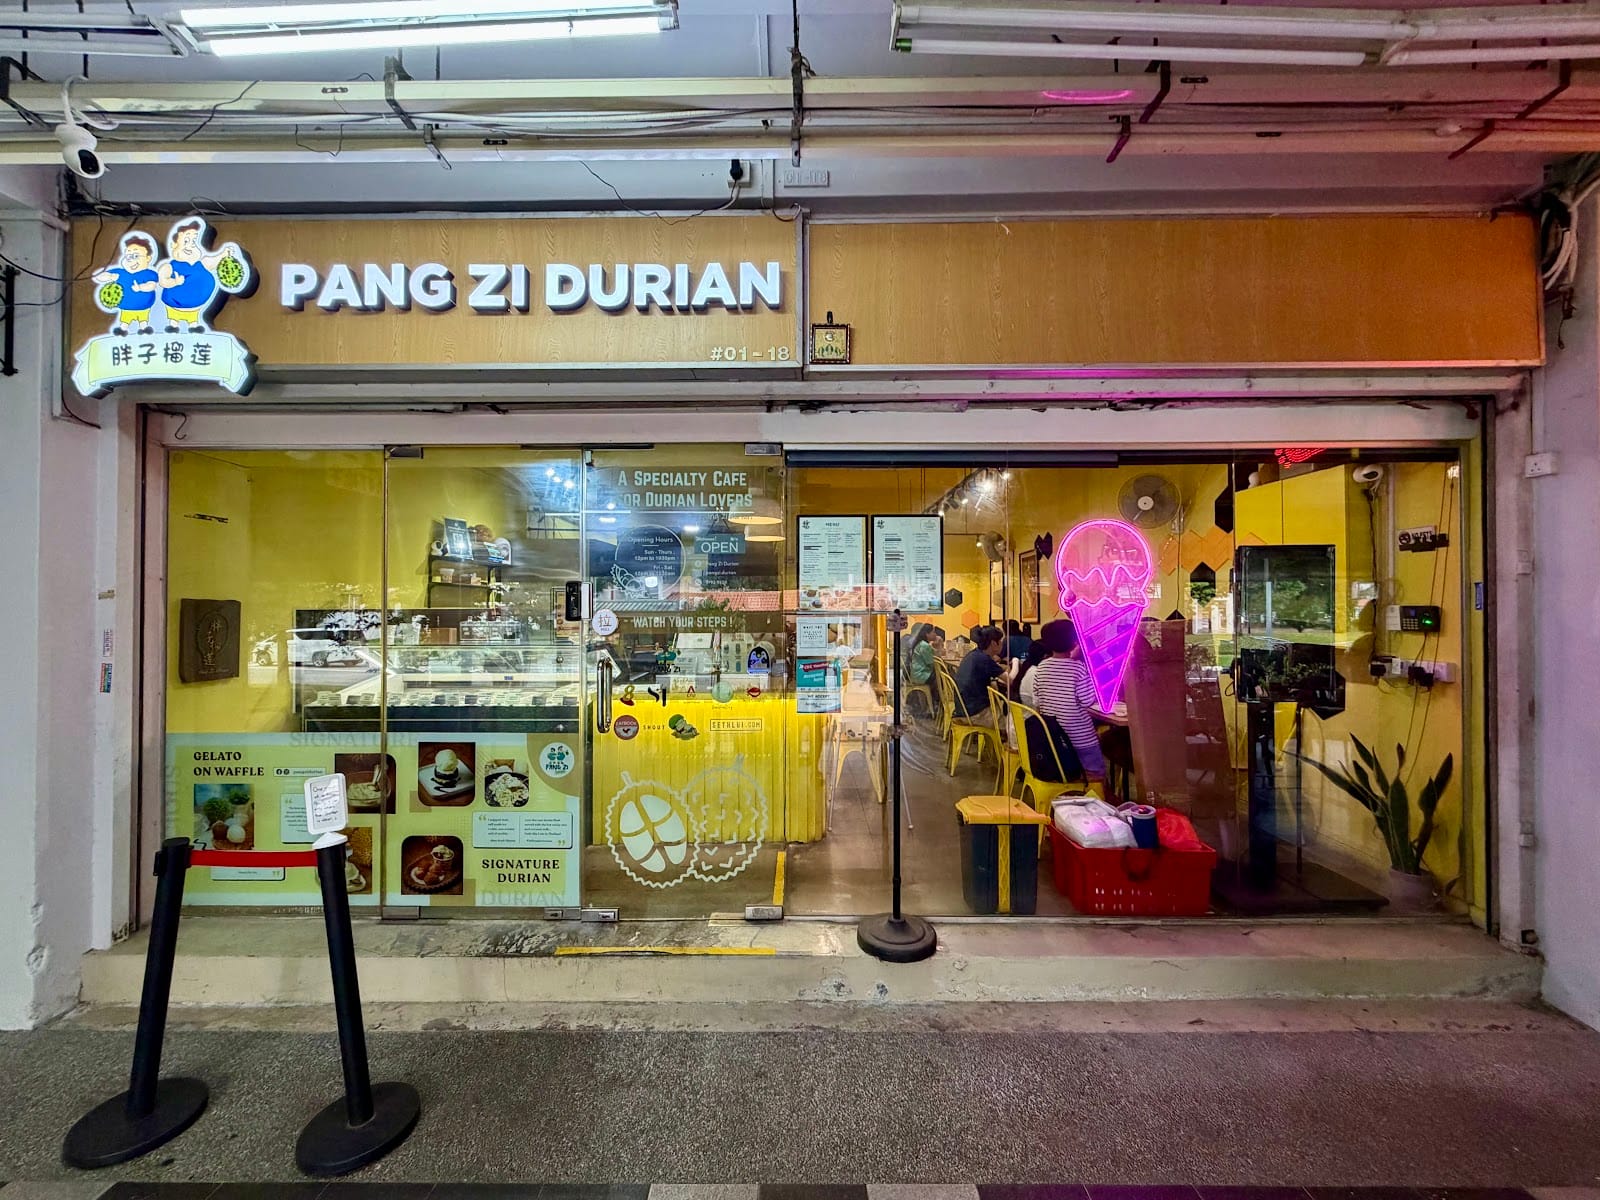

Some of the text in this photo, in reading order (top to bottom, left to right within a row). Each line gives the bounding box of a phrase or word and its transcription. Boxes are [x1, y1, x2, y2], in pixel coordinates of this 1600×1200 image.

[281, 262, 781, 310] PANG ZI DURIAN
[112, 341, 212, 366] 胖子榴莲
[701, 541, 739, 553] OPEN
[633, 617, 665, 628] WATCH
[669, 617, 694, 628] YOUR
[697, 617, 727, 628] STEPS
[193, 752, 242, 761] GELATO
[193, 767, 264, 777] ON WAFFLE
[482, 860, 560, 869] SIGNATURE
[497, 873, 551, 883] DURIAN
